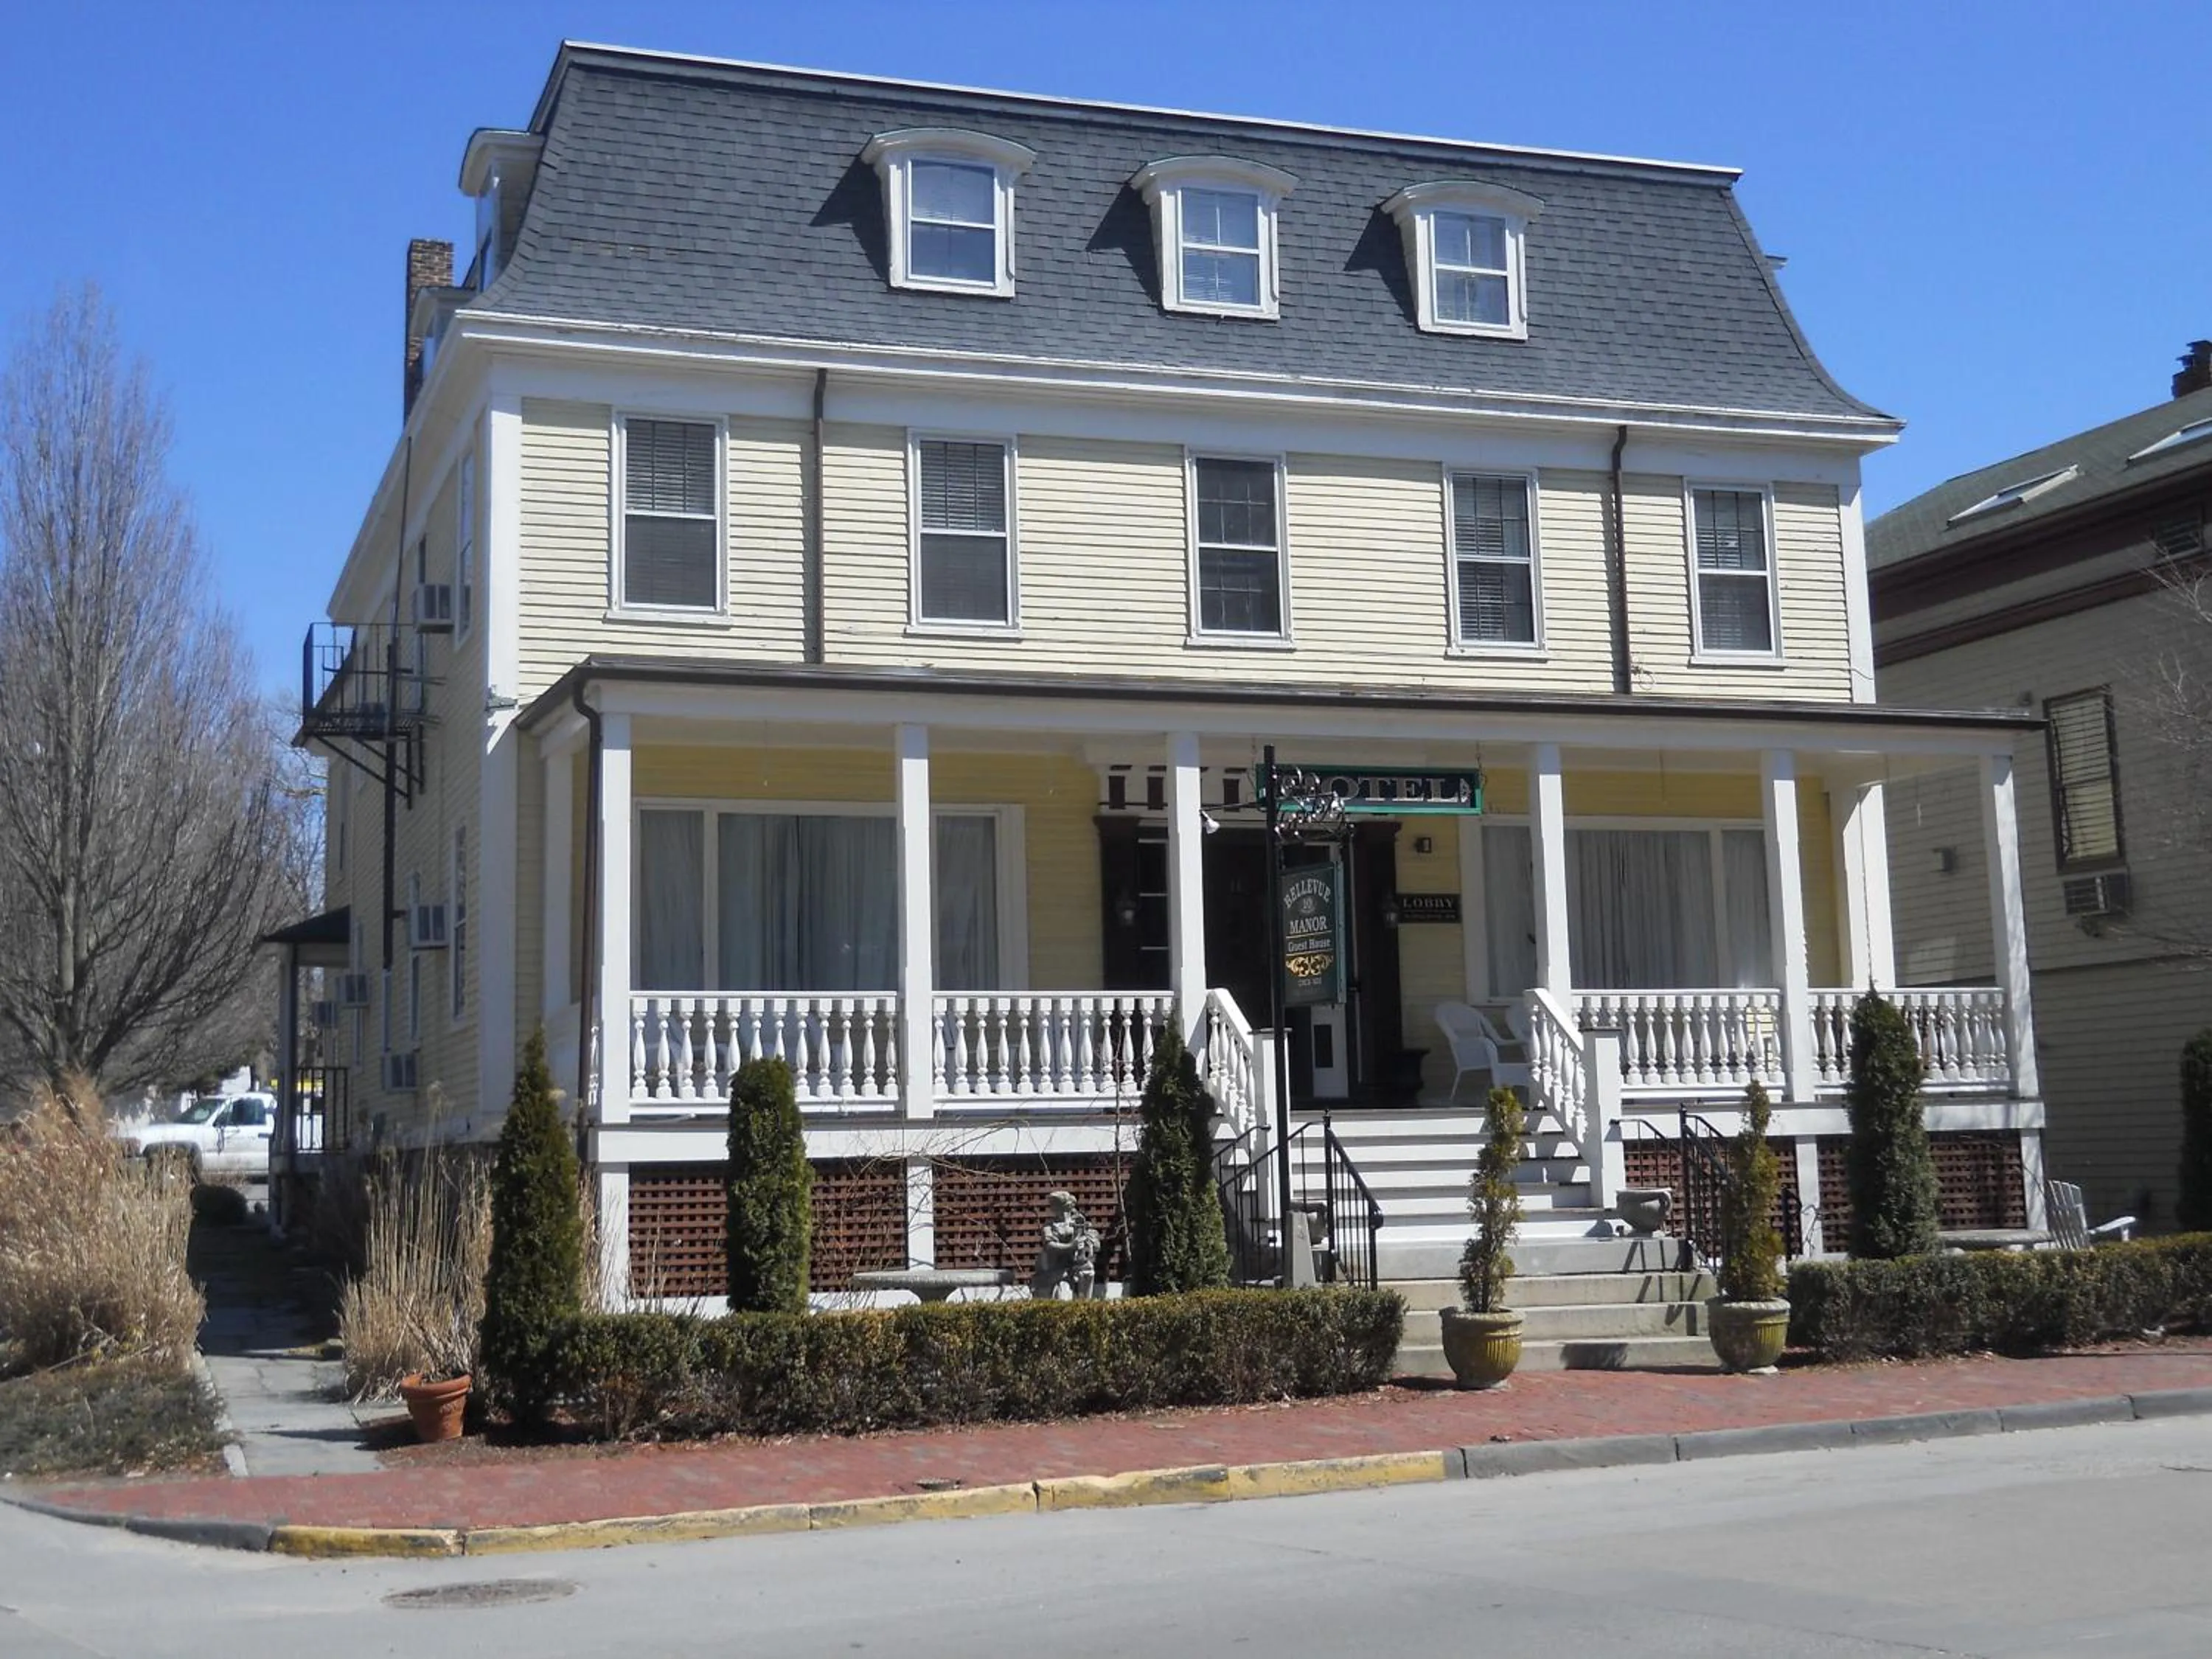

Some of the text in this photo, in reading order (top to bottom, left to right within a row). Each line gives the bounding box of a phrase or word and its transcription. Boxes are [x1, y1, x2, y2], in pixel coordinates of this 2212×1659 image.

[1283, 878, 1331, 908] BELLEVUE
[1402, 897, 1454, 909] LOBBY
[1289, 916, 1328, 934] MANOR
[1288, 939, 1331, 952] Guest House
